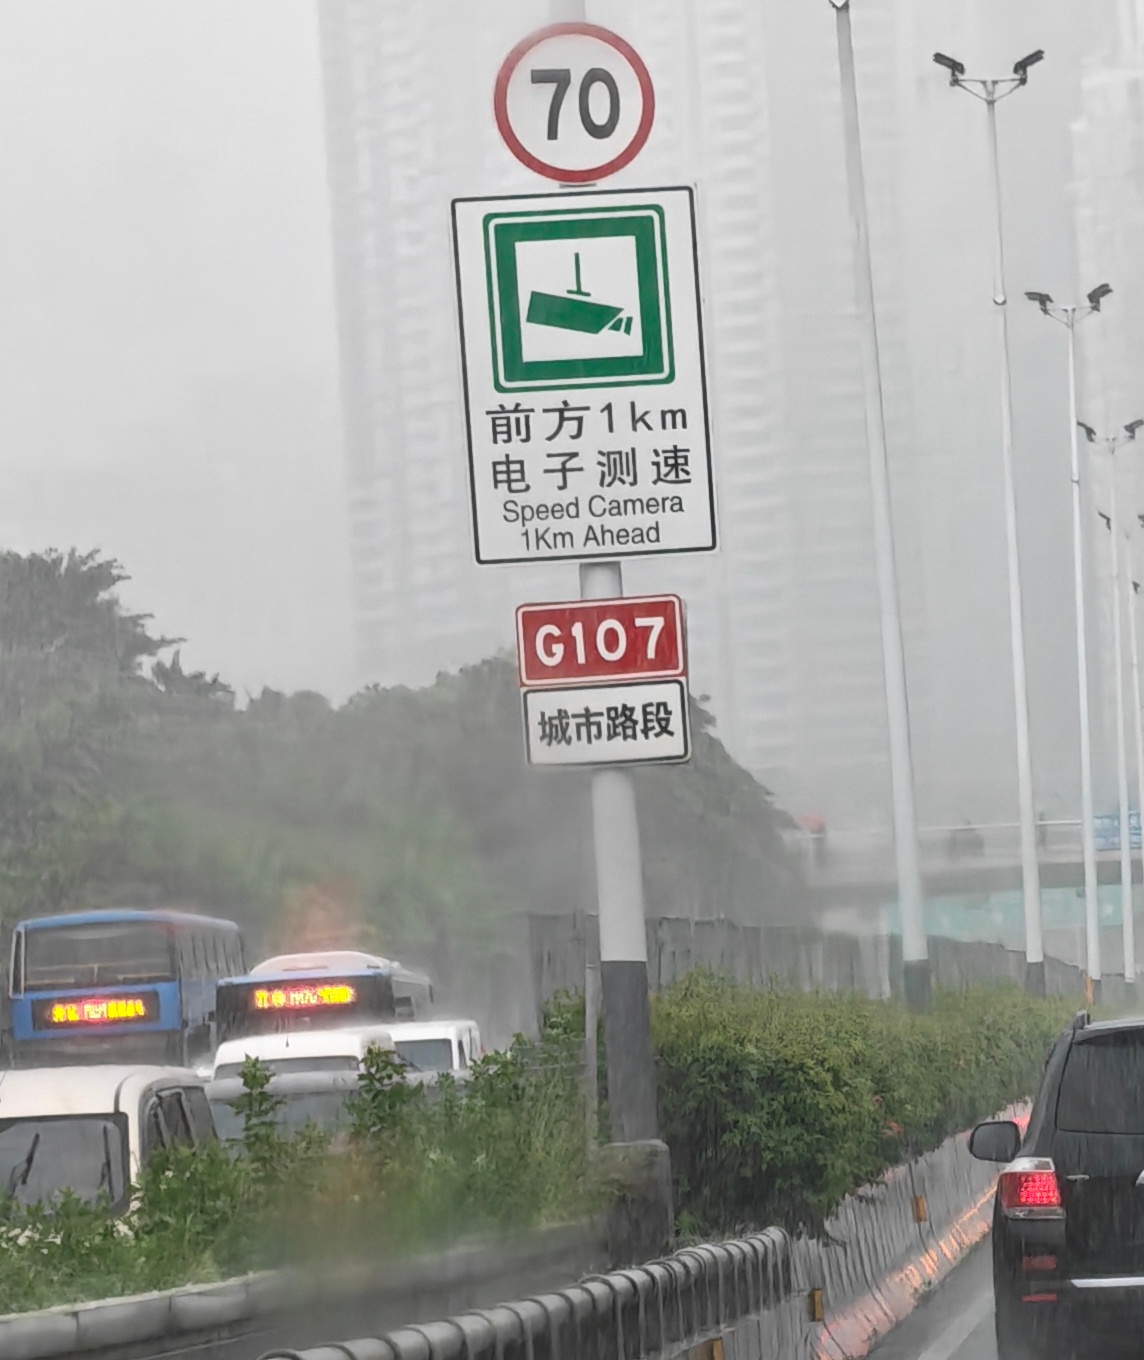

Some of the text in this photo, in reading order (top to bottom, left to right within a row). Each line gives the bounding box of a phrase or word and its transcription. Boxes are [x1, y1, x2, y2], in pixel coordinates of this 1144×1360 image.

[531, 67, 621, 141] 70
[491, 445, 692, 494] 电子测速
[502, 494, 685, 527] Speed Camera
[521, 520, 661, 551] 1Km Ahead
[535, 616, 665, 667] G107
[538, 701, 675, 747] 城市路段
